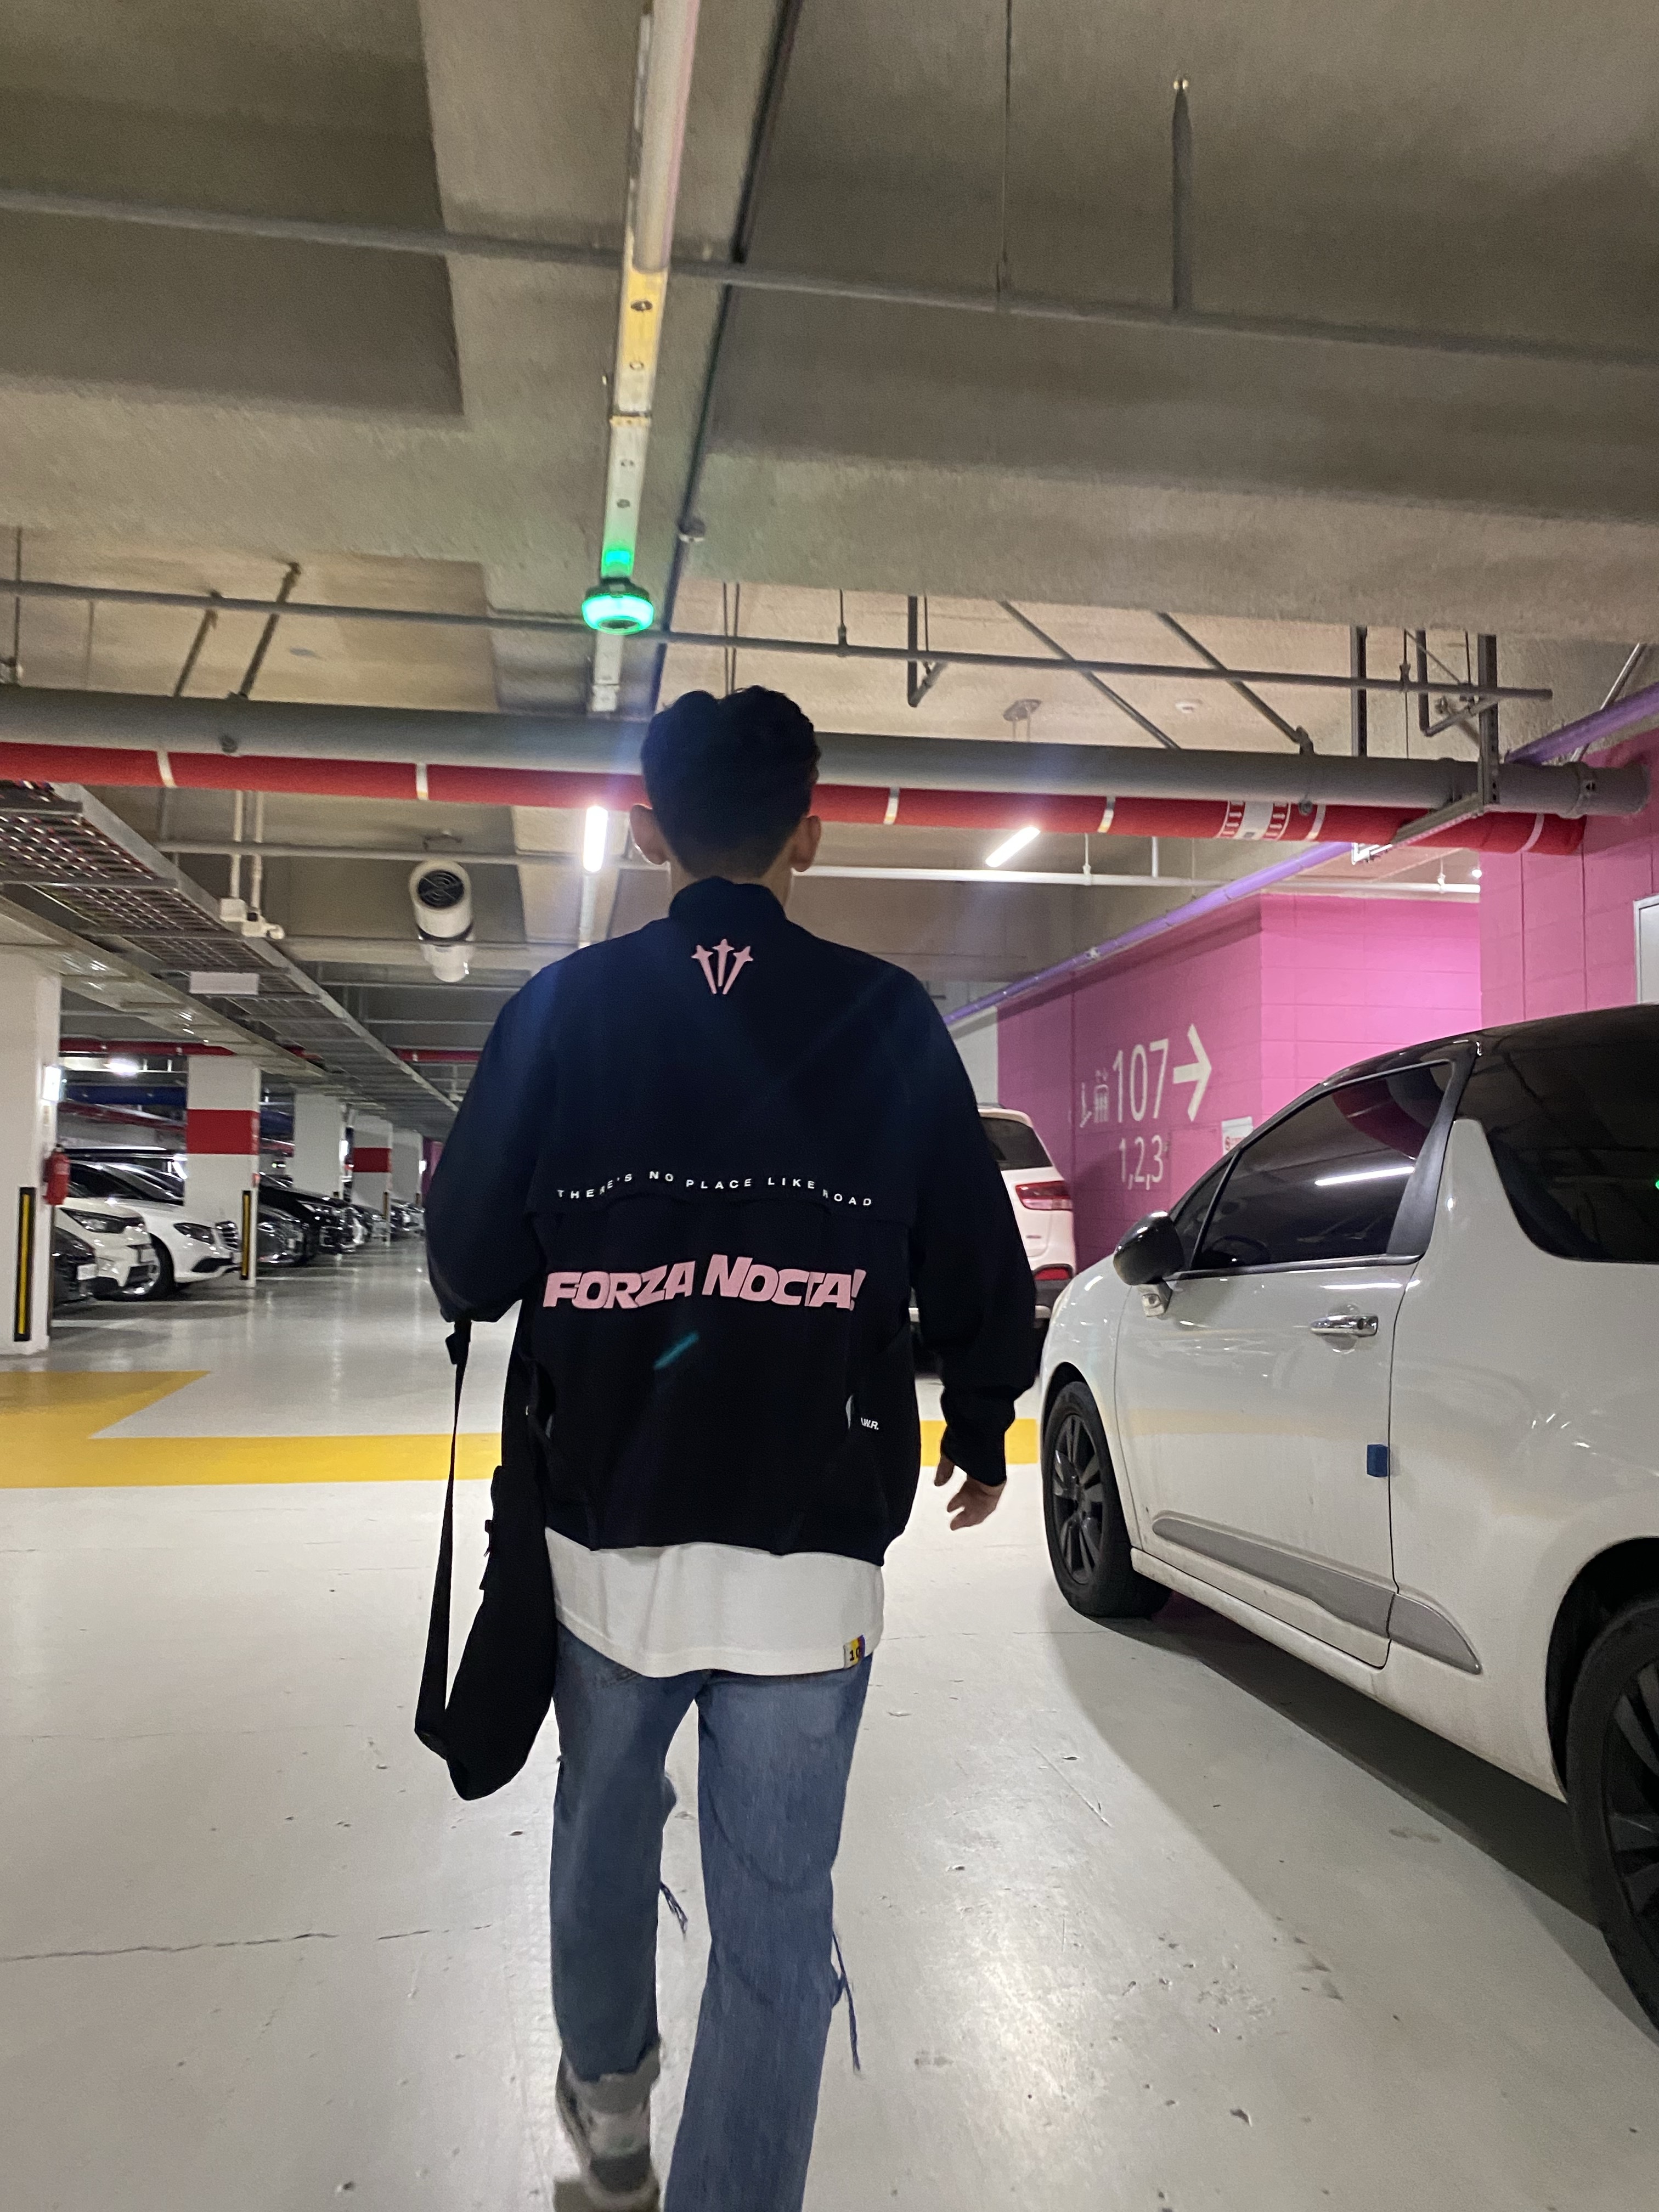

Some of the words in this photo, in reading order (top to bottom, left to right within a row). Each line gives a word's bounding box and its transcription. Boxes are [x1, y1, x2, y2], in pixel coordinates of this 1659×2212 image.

[1113, 1038, 1169, 1124] 107
[556, 1173, 633, 1199] THERE'S
[649, 1171, 674, 1182] NO
[686, 1178, 752, 1189] PLACE
[768, 1177, 815, 1189] LIKE
[822, 1189, 872, 1206] ROAD
[1119, 1135, 1164, 1190] 1,2,3
[543, 1261, 696, 1309] FORZA
[702, 1254, 866, 1311] NOCTA!
